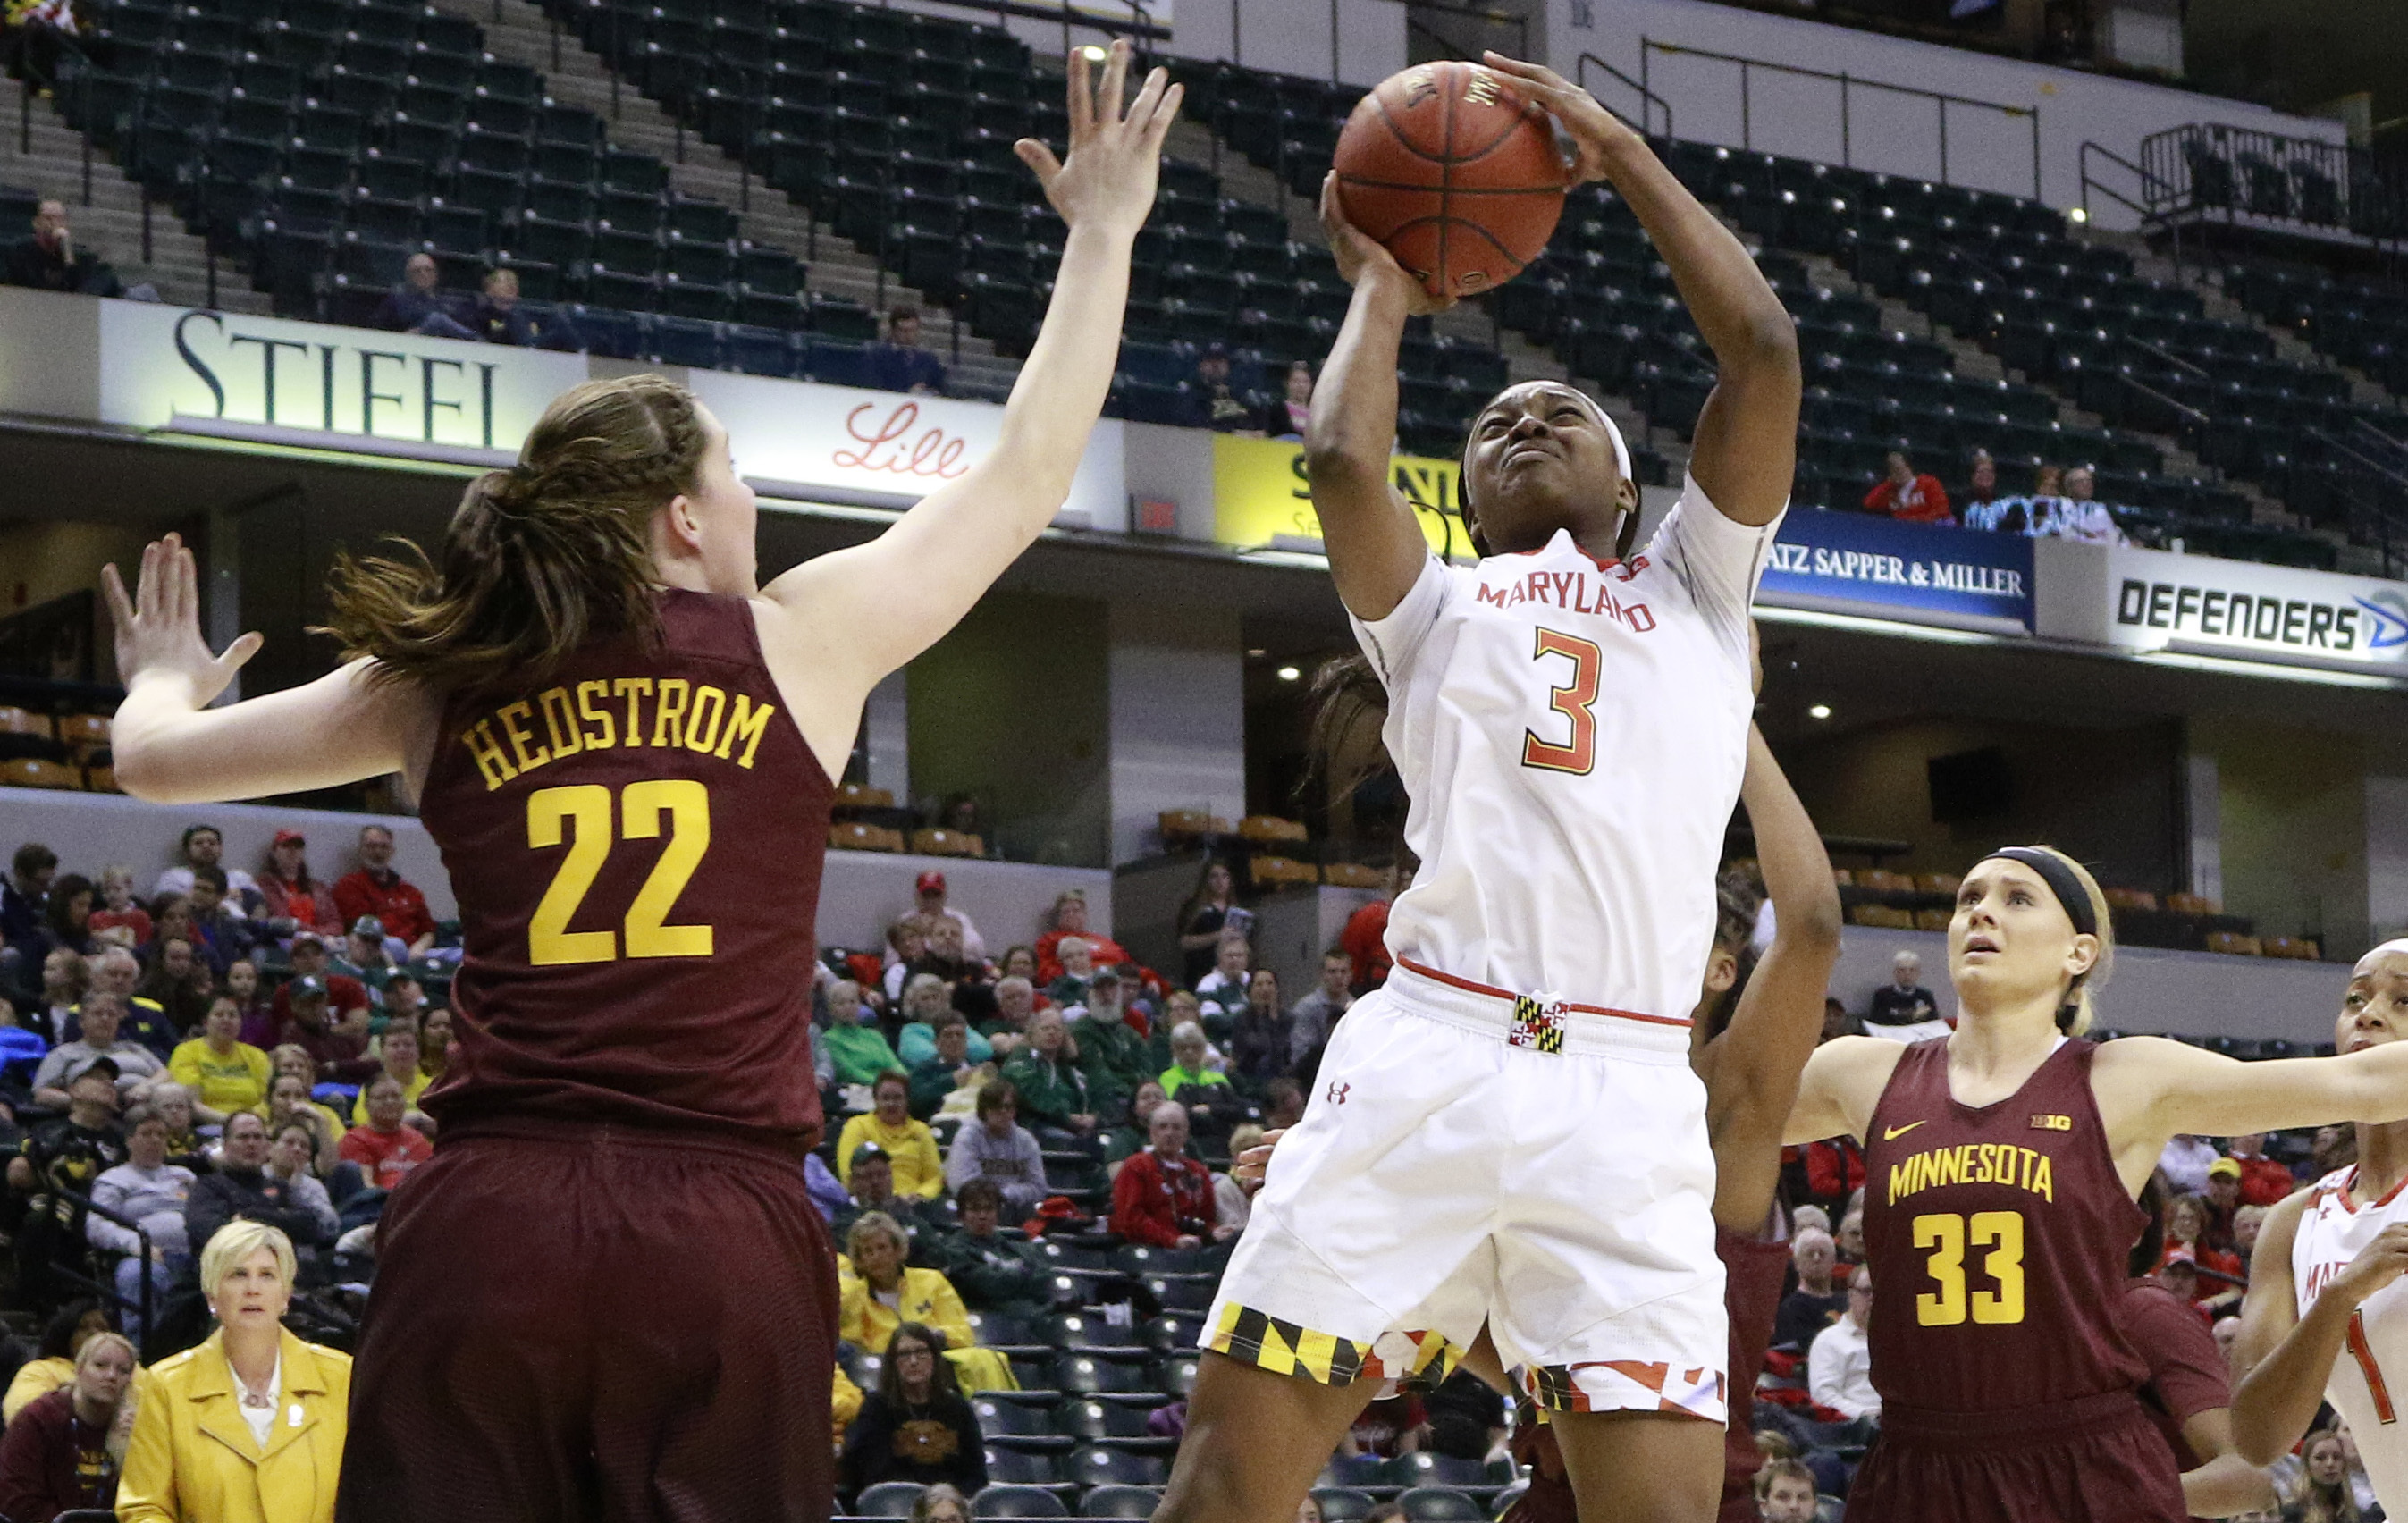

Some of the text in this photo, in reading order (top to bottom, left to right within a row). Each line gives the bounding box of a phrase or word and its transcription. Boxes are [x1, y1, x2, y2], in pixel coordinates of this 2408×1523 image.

[1814, 547, 1907, 584] SAPPER
[1909, 560, 1930, 587] &
[1932, 560, 2025, 597] MILLER
[2118, 577, 2359, 650] DEFENDERS
[462, 677, 775, 792] HEDSTROM
[1521, 626, 1602, 776] 3
[527, 779, 713, 966] 22
[1889, 1143, 2053, 1207] MINNESOTA
[1913, 1211, 2025, 1326] 33
[2345, 1308, 2397, 1424] 1
